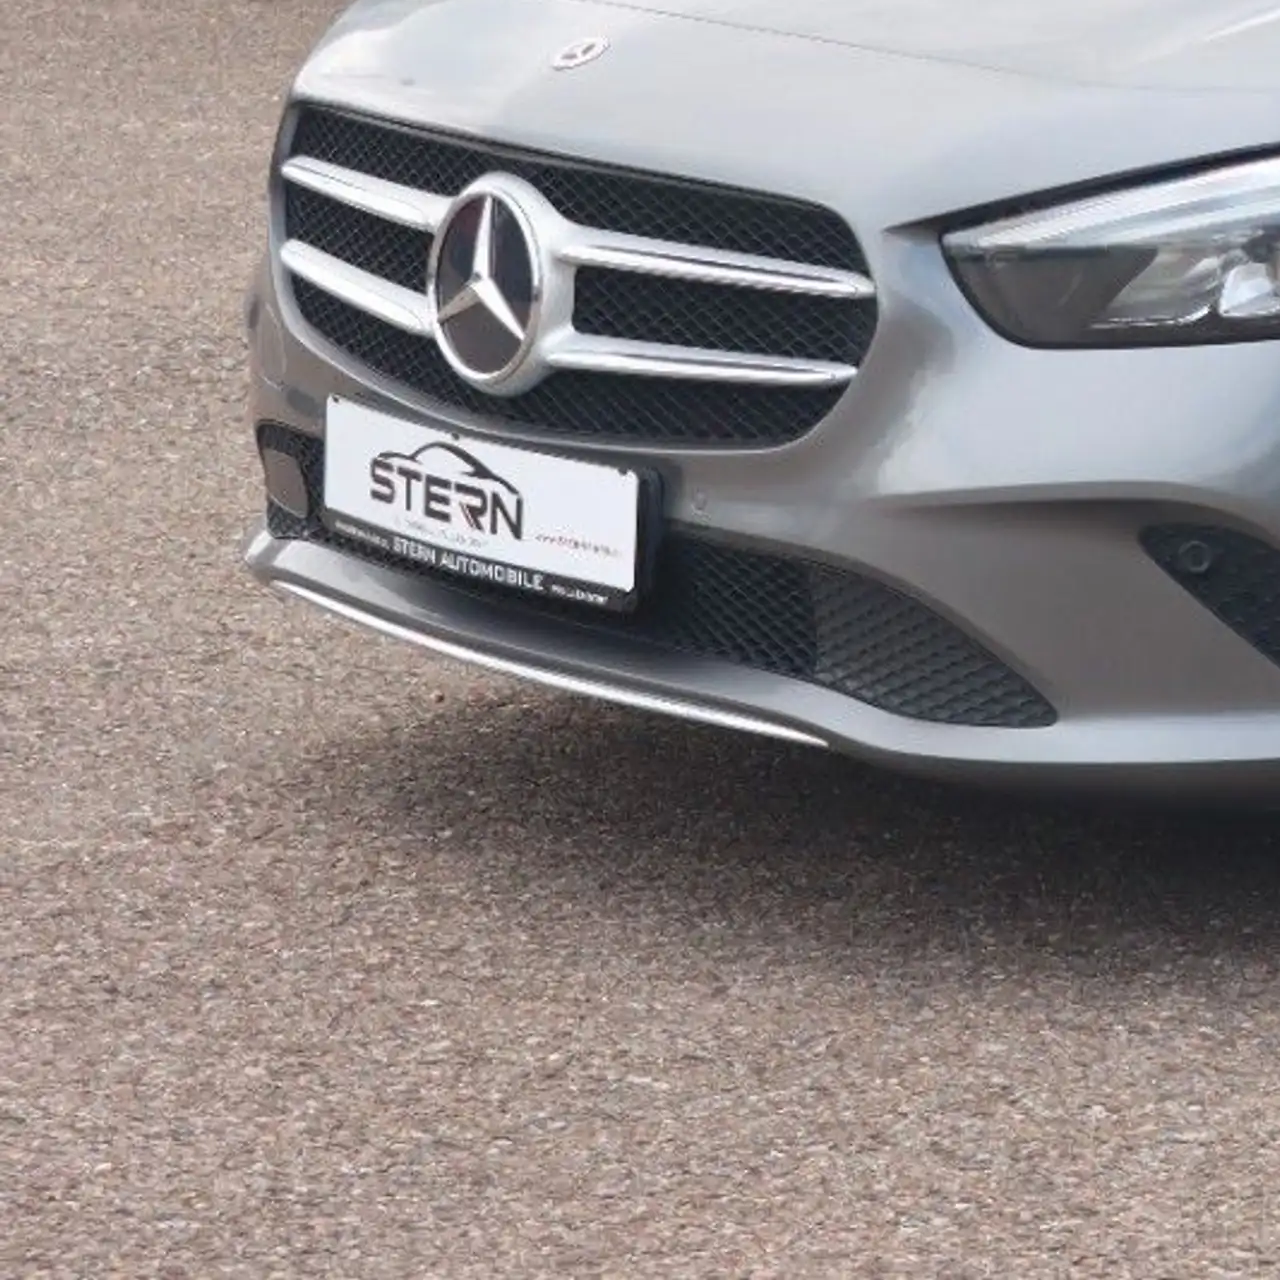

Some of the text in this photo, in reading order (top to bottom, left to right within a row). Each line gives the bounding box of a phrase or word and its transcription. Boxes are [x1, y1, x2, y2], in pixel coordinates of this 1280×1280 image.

[369, 457, 524, 541] STERN
[393, 536, 544, 590] STERN AUTOMOBILE
